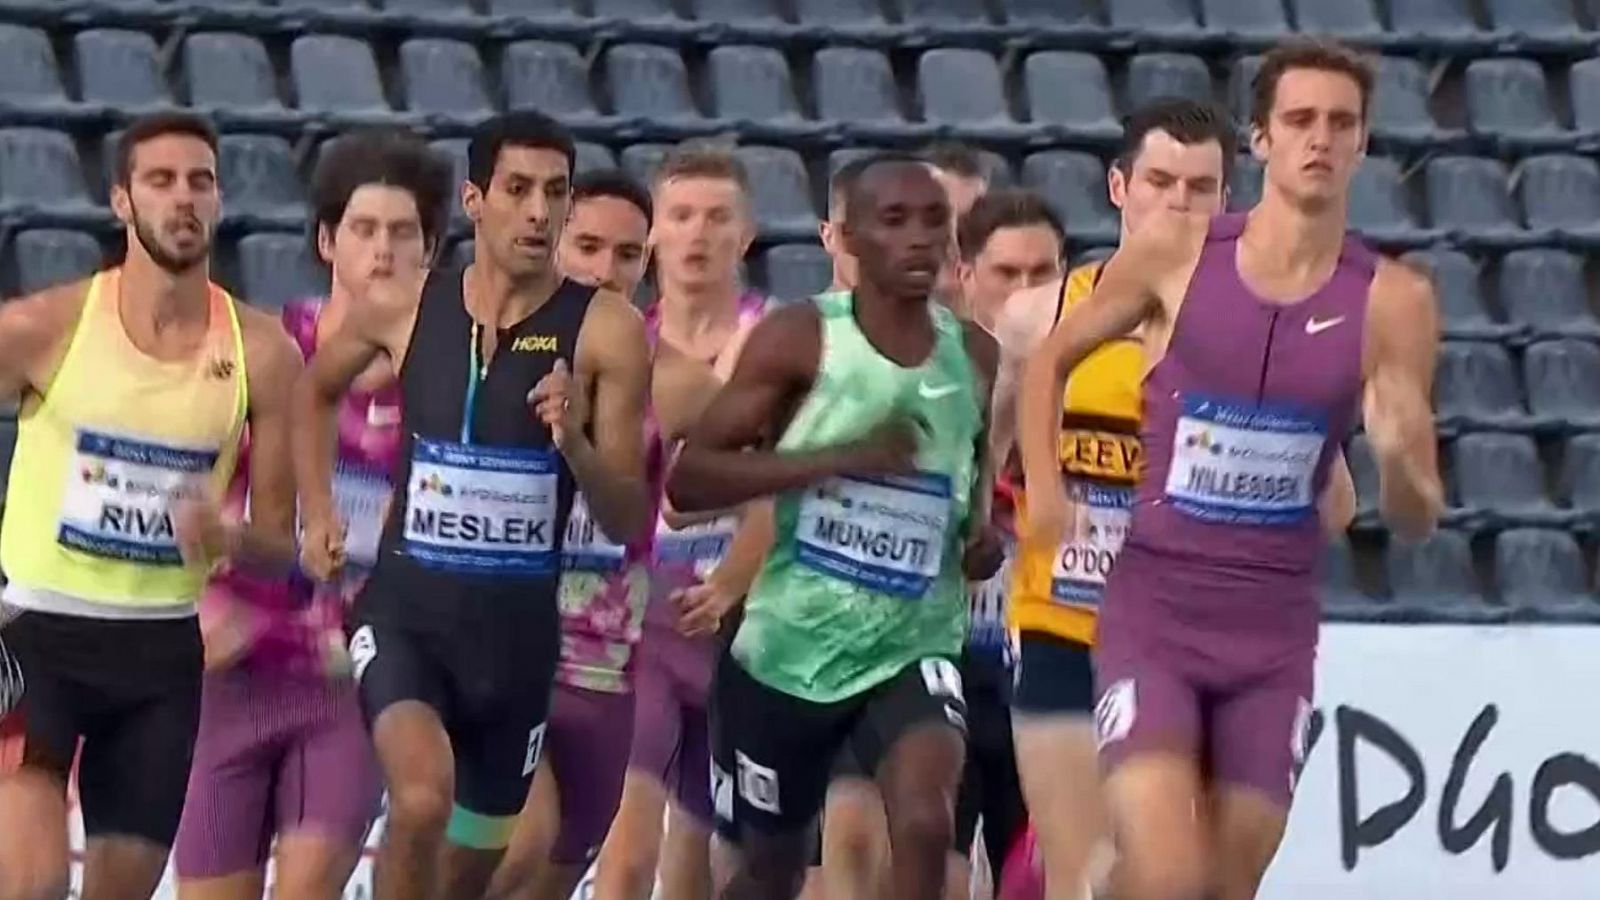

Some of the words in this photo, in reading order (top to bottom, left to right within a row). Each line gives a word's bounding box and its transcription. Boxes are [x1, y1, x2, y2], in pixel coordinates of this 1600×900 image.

[511, 336, 558, 352] HOKA
[412, 508, 548, 546] MESLEK
[814, 516, 929, 566] MUNGUTI
